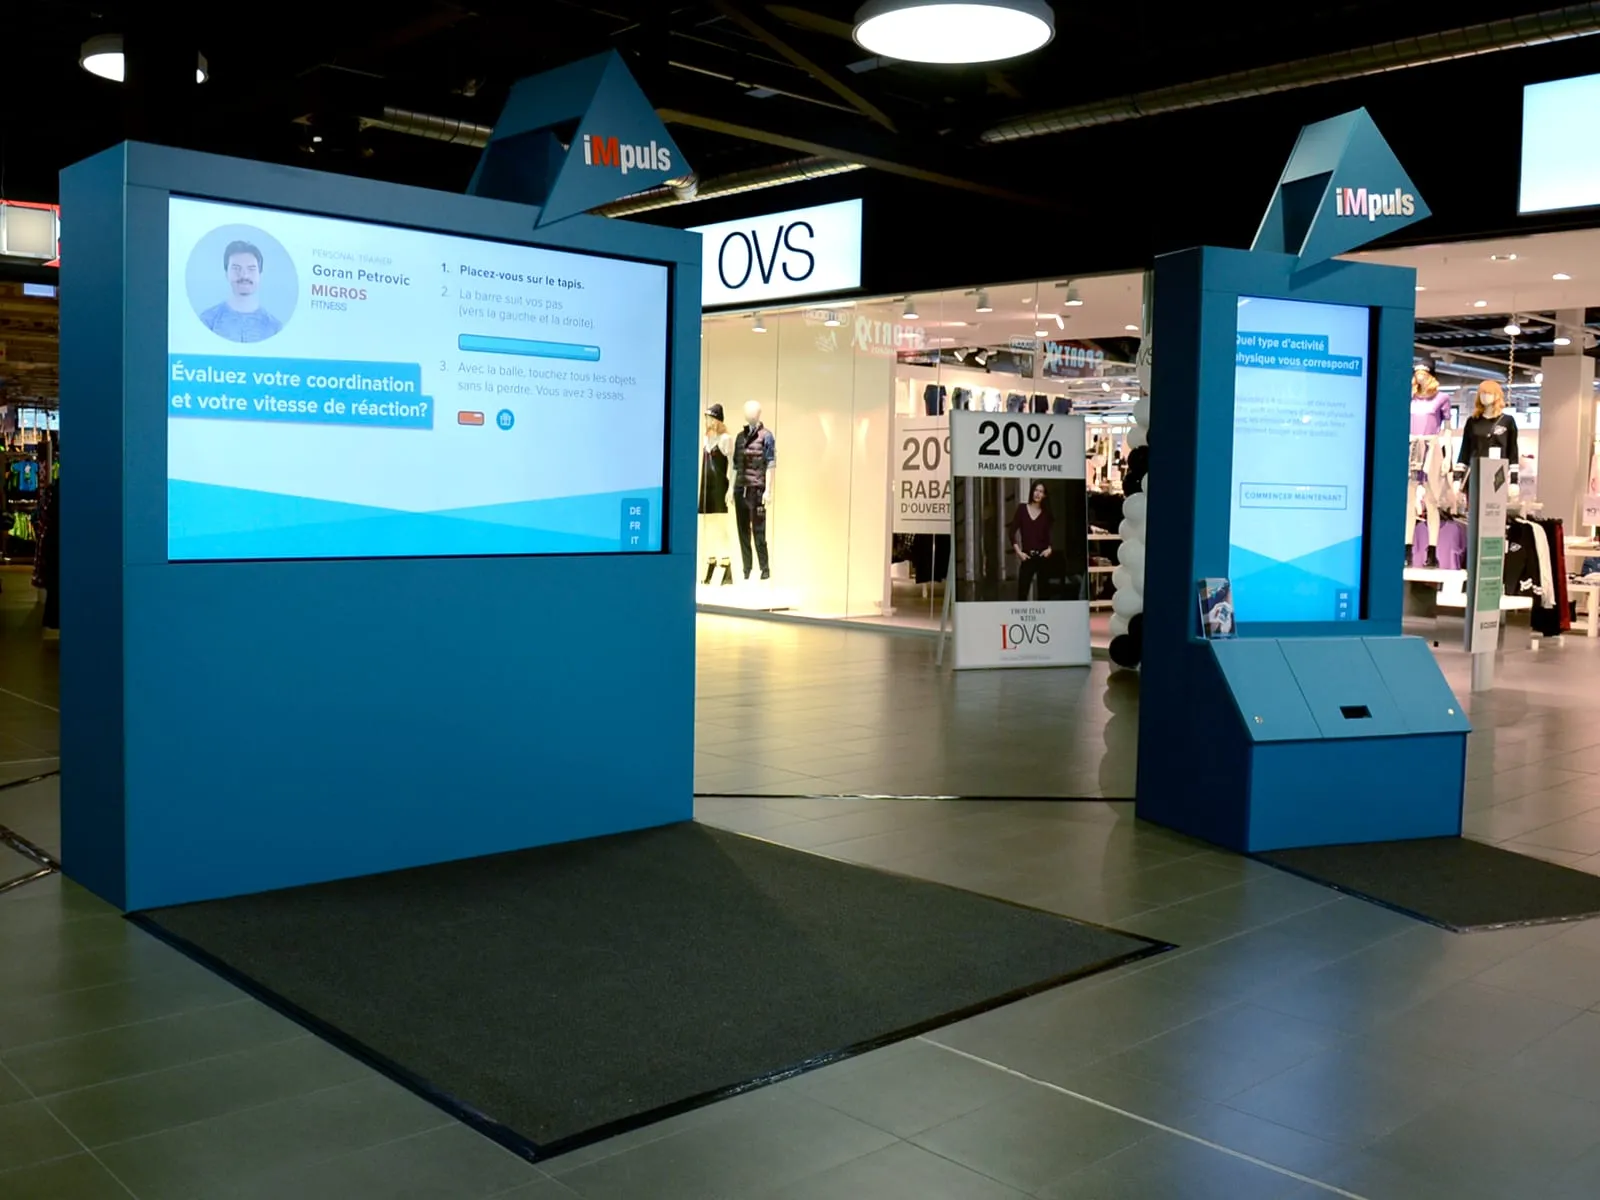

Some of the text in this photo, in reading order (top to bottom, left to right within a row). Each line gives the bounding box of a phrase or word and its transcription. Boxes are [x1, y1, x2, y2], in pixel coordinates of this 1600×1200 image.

[584, 134, 671, 175] iMpuls
[1336, 187, 1415, 222] iMpuls
[312, 248, 393, 266] PERSONAL TRAINER
[718, 221, 815, 289] OVS
[312, 264, 411, 286] Goran Petrovic
[460, 265, 524, 283] Placez-vous
[527, 275, 543, 285] sur
[545, 276, 555, 286] le
[558, 278, 585, 290] tapis.
[311, 284, 368, 301] MIGROS
[459, 290, 471, 300] La
[475, 291, 503, 303] barre
[505, 294, 522, 305] suit
[525, 298, 543, 308] vos
[545, 300, 563, 311] pas
[311, 300, 347, 311] FITNESS
[458, 306, 484, 318] (vers
[487, 307, 497, 318] la
[499, 310, 537, 323] gauche
[539, 313, 549, 324] et
[551, 314, 561, 326] la
[1258, 336, 1279, 349] type
[1281, 338, 1325, 351] d'activité
[1278, 357, 1301, 367] vous
[1303, 358, 1360, 371] correspond?
[171, 360, 415, 393] Évaluez votre coordination
[458, 362, 484, 374] Avec
[487, 364, 496, 375] la
[529, 368, 567, 381] touchez
[570, 371, 590, 383] tous
[592, 372, 607, 383] les
[609, 374, 636, 387] objets
[458, 382, 482, 392] sans
[484, 381, 494, 393] la
[537, 385, 560, 397] Vous
[563, 388, 584, 399] avez
[587, 388, 594, 399] 3
[171, 392, 428, 418] et votre vitesse de réaction?
[978, 420, 1062, 460] 20%
[978, 462, 1063, 473] RABAIS D'OUVERTURE
[1244, 492, 1342, 502] COMMENCER MAINTENANT
[629, 506, 641, 516] DE
[629, 521, 641, 530] FR
[630, 535, 639, 545] IT
[1000, 623, 1050, 650] LOVS
